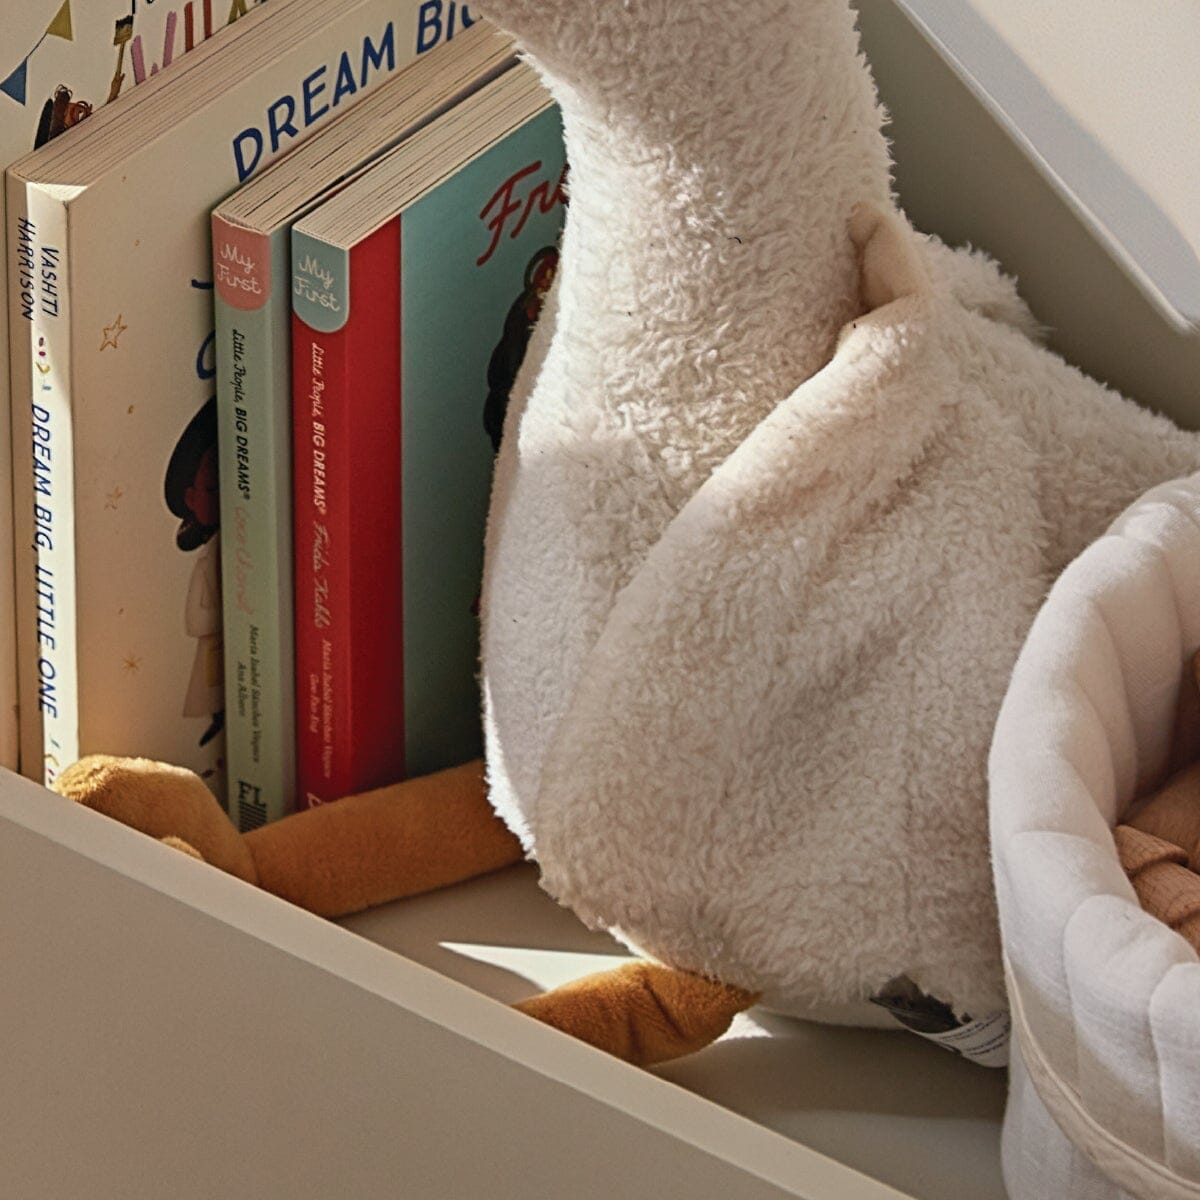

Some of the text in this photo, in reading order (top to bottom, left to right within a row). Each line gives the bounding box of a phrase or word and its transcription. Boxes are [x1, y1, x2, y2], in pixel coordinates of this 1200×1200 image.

[232, 21, 396, 183] DREAM
[17, 216, 36, 321] HARRISON
[220, 243, 256, 274] My
[299, 255, 335, 289] My
[41, 246, 60, 317] VASHTI
[216, 262, 262, 294] First
[294, 275, 340, 311] First
[232, 328, 245, 362] Little
[312, 342, 326, 375] Little
[231, 362, 247, 403] People,
[235, 407, 248, 432] BIG
[312, 422, 326, 448] BIG
[31, 403, 58, 719] DREAM BIG, LITTLE ONE
[313, 520, 331, 573] Frida
